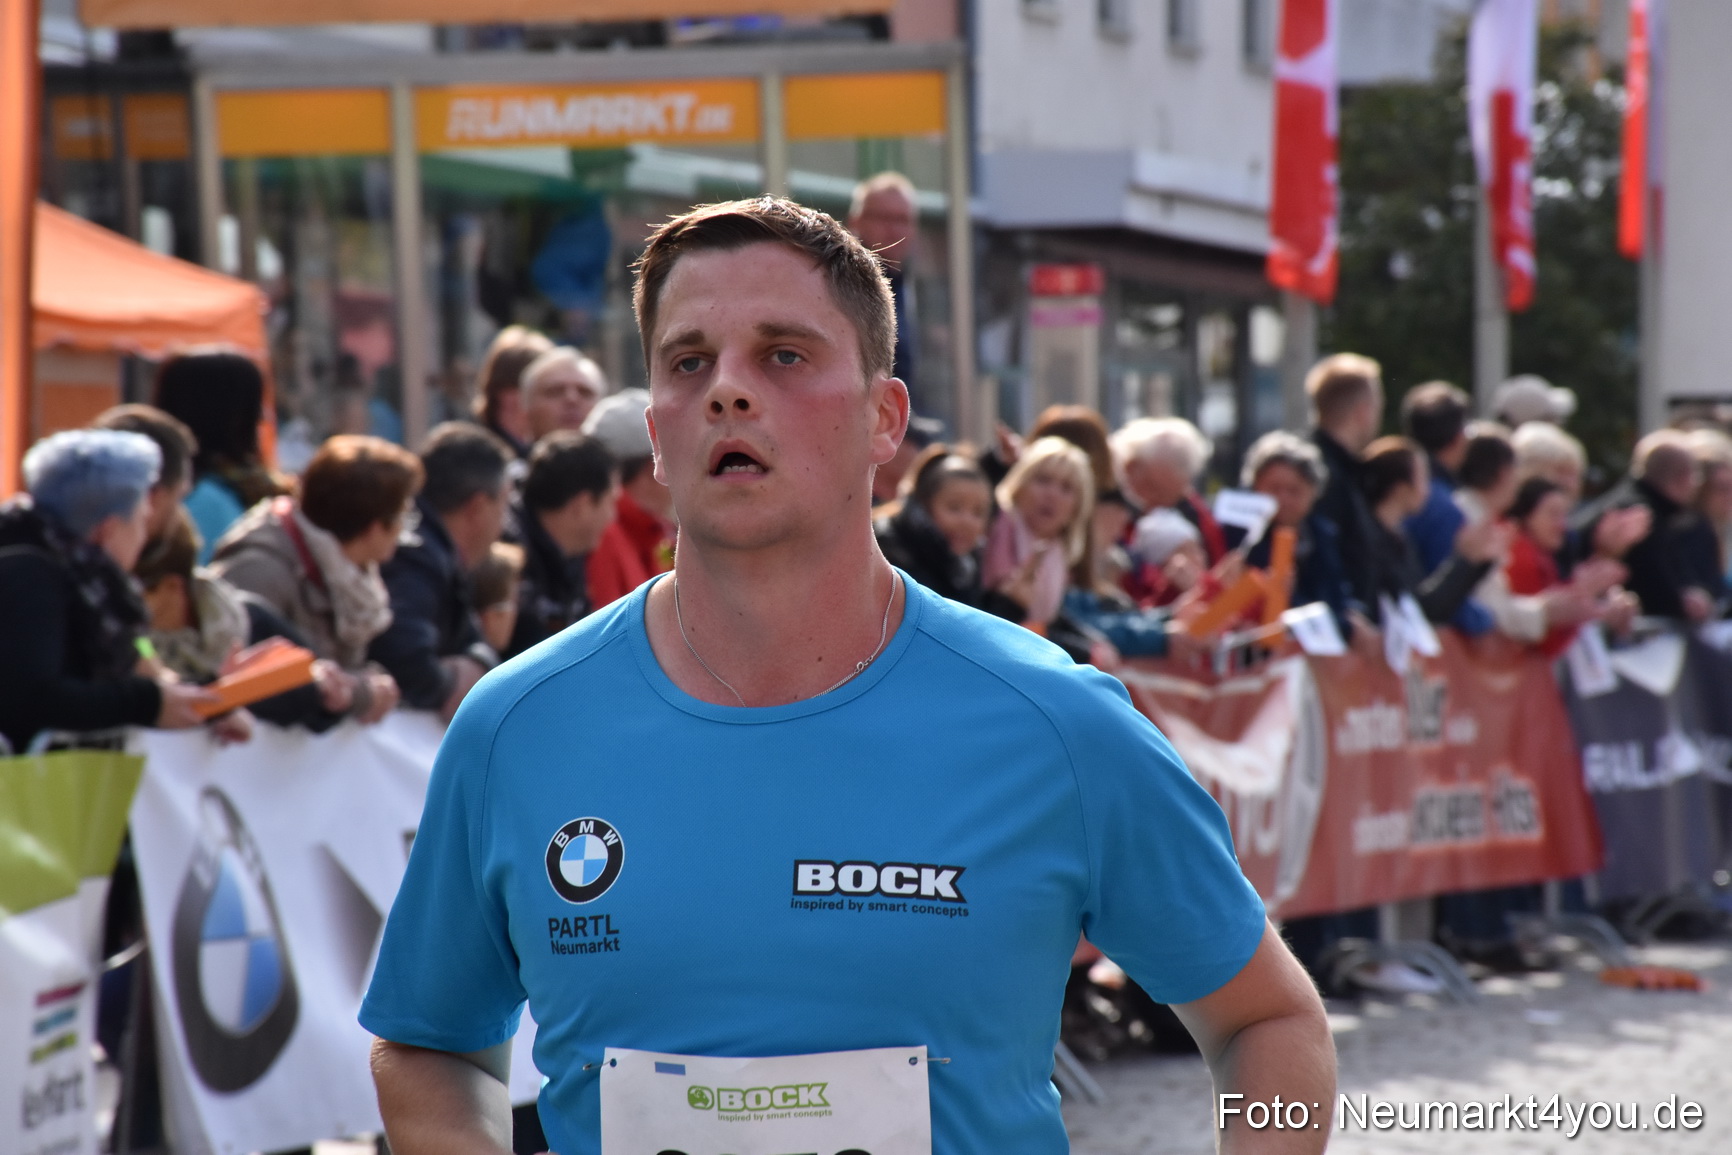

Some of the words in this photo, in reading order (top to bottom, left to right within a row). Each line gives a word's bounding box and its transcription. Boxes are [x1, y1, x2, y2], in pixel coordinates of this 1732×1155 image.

[554, 820, 619, 848] BMW
[793, 860, 967, 903] BOCK
[790, 898, 844, 911] inspired
[848, 899, 864, 913] by
[868, 902, 907, 913] smart
[911, 904, 969, 918] concepts
[548, 914, 620, 938] PARTL
[551, 937, 620, 955] Neumarkt
[717, 1083, 831, 1112] BOCK
[717, 1113, 752, 1122] inspired
[753, 1113, 764, 1122] by
[766, 1111, 791, 1120] smart
[793, 1109, 832, 1118] concepts
